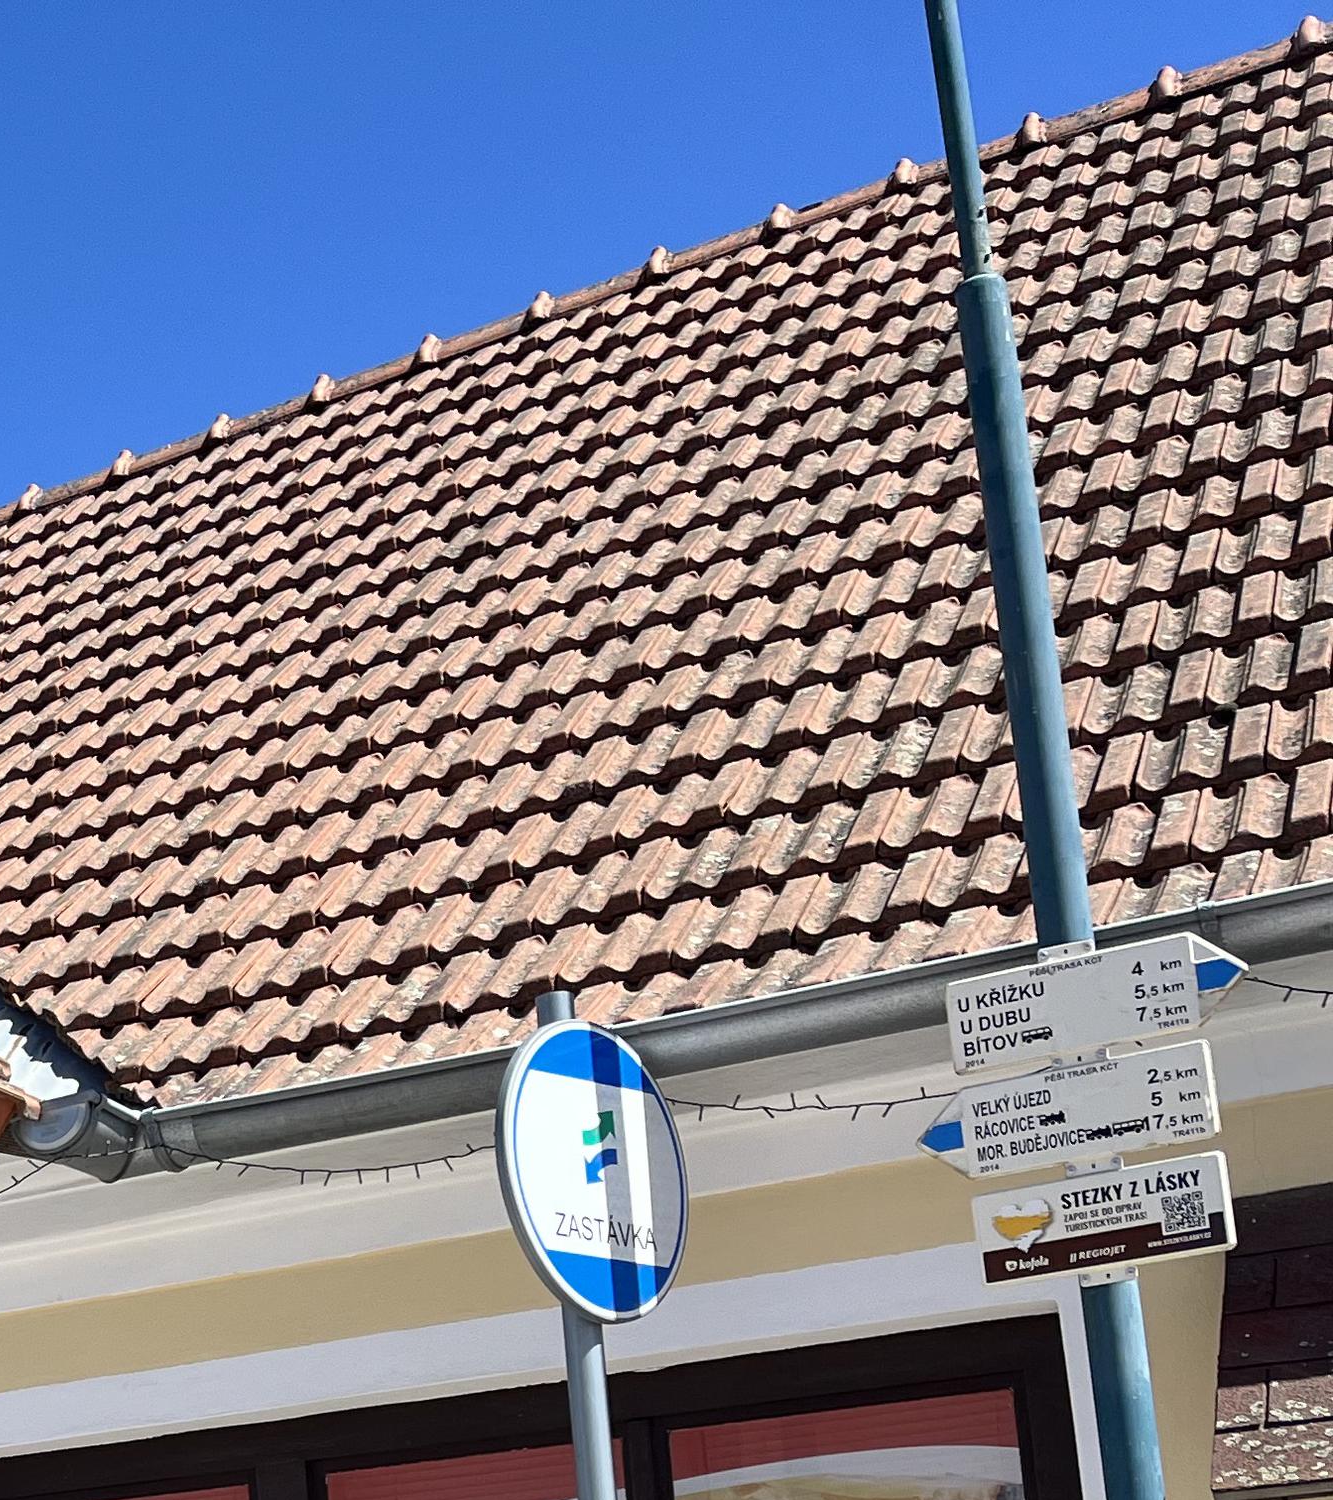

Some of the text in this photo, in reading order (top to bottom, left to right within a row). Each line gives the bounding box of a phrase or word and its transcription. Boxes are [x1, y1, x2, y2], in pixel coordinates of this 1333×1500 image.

[1051, 960, 1082, 973] TRASA
[1131, 959, 1182, 976] 4 km
[957, 981, 1045, 1013] U KŘÍŽKU
[1134, 981, 1185, 1000] 5,5 km
[1165, 1004, 1188, 1016] km
[960, 1007, 1031, 1035] U DUBU
[963, 1031, 1018, 1057] BÍTOV
[965, 1058, 985, 1068] 2014
[1067, 1067, 1098, 1079] TRASA
[1147, 1067, 1198, 1085] 2,5 km
[972, 1089, 1052, 1117] VELKÝ ÚJEZD
[1151, 1091, 1201, 1106] 5 km
[974, 1115, 1035, 1140] RÁCOVICE
[1181, 1113, 1204, 1125] km
[977, 1128, 1085, 1162] MOR. BUDĚJOVICE
[979, 1164, 1000, 1174] 2014
[1061, 1169, 1201, 1210] STEZKY Z LÁSKY
[1063, 1201, 1142, 1223] ZAPOJ SE DO OPRAV
[554, 1211, 659, 1253] ZASTÁVKA
[1064, 1215, 1123, 1233] TURISTICKÝCH
[1079, 1244, 1127, 1260] REGIOJET
